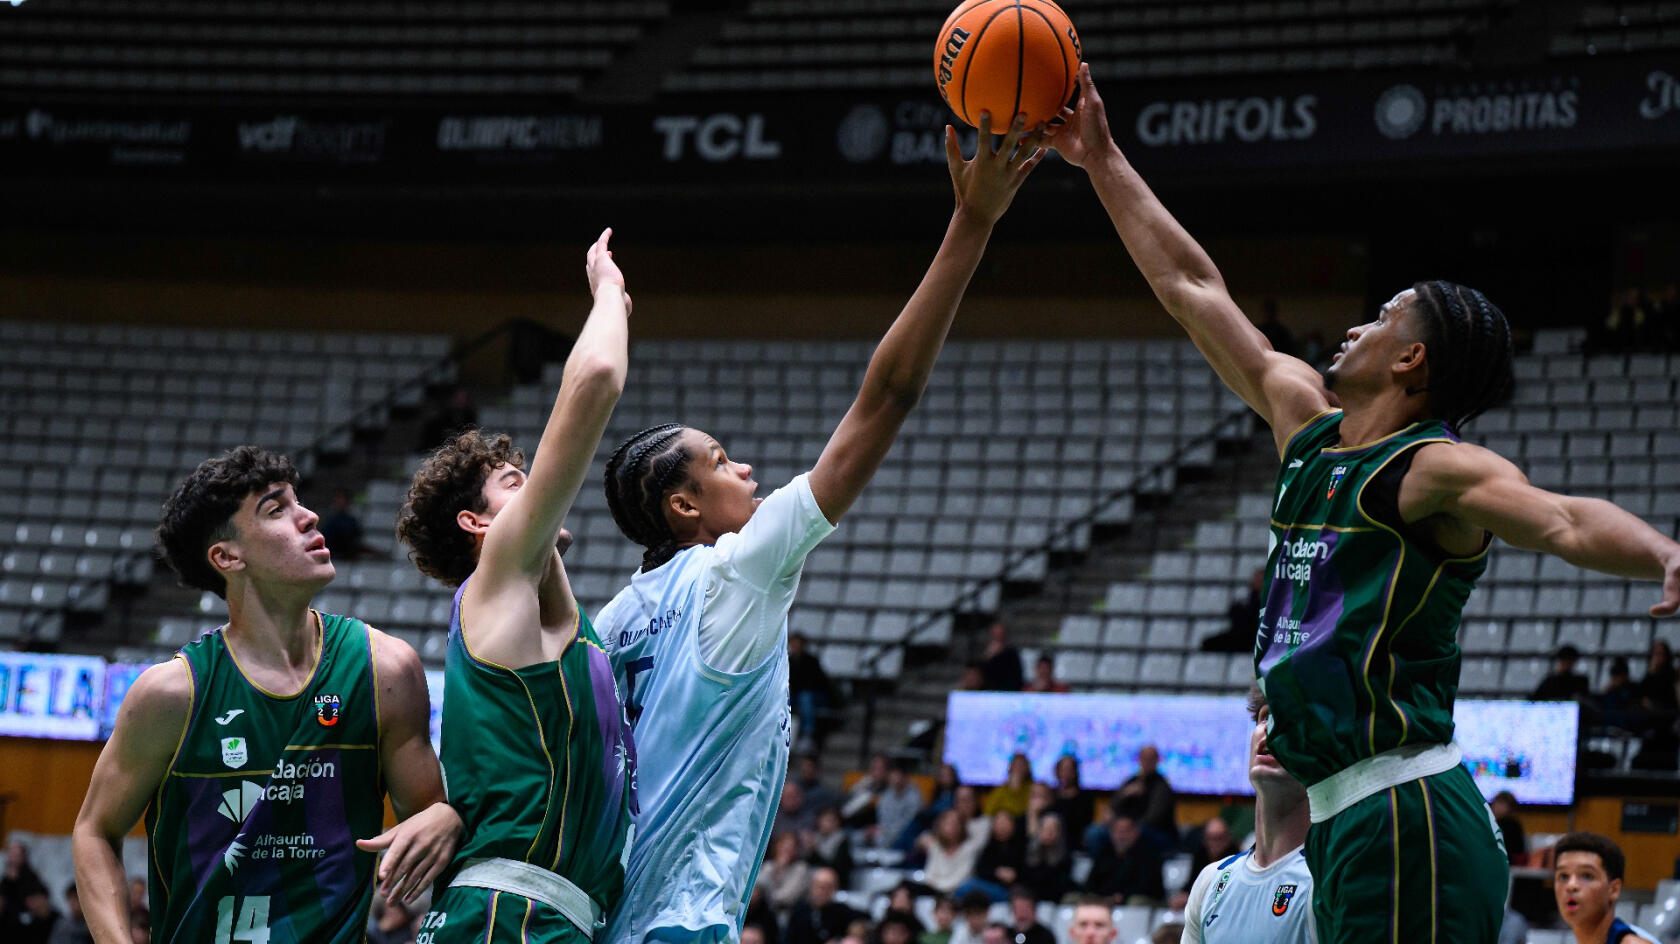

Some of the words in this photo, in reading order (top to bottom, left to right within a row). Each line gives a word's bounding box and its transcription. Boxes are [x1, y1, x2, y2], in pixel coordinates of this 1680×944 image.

[1136, 95, 1320, 147] GRIFOLS
[1432, 92, 1579, 136] PROBITAS
[654, 113, 782, 162] TCL
[314, 695, 340, 704] LIGA
[272, 757, 335, 779] dación
[260, 780, 305, 805] icaja
[254, 833, 314, 847] Alhaurín
[251, 847, 269, 860] de
[271, 846, 285, 859] la
[288, 846, 326, 859] Torre
[1277, 886, 1294, 894] LIGA
[215, 895, 271, 944] 14
